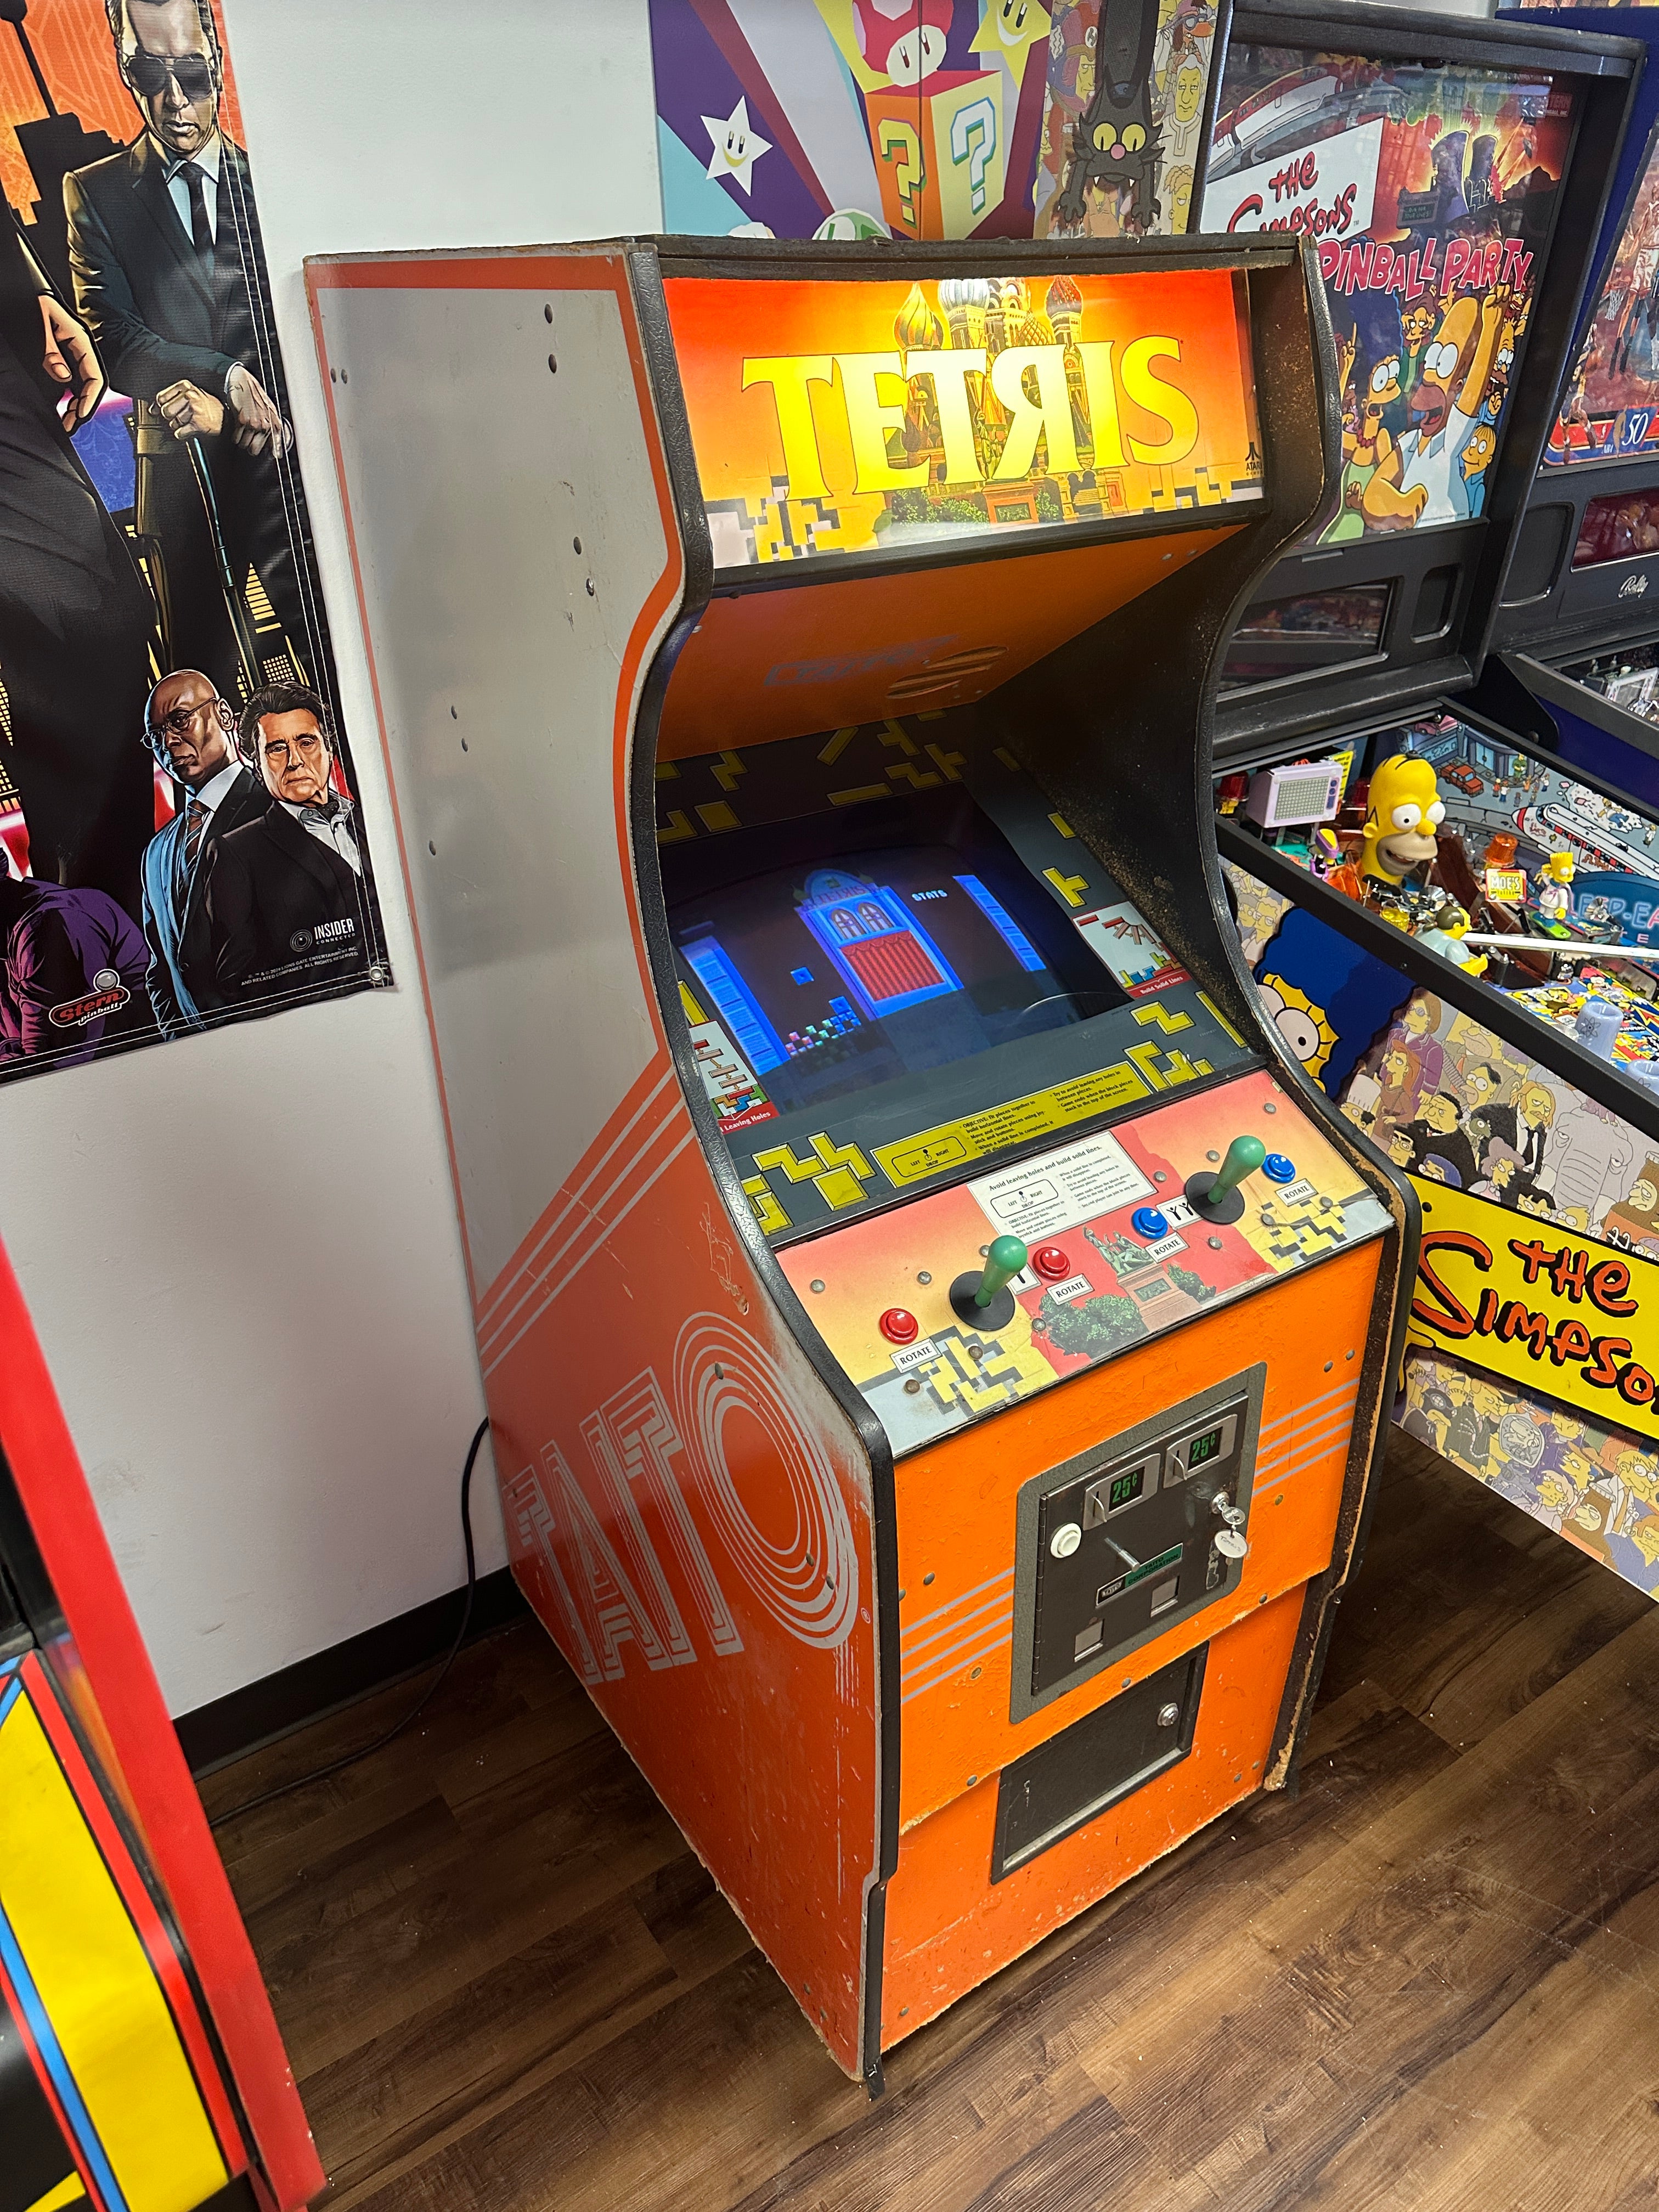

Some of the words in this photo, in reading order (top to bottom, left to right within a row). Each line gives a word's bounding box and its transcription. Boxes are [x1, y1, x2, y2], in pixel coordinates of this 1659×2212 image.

[1318, 238, 1437, 302] PINBALL
[1440, 238, 1534, 297] PARTY
[1622, 413, 1649, 446] 50
[1491, 876, 1521, 890] MOE'S
[911, 889, 948, 901] STATS
[314, 918, 354, 940] INSIDER
[316, 933, 356, 945] CONNECTED
[252, 974, 276, 983] RELATED
[1154, 980, 1169, 989] Solid
[59, 993, 119, 1020] Stern
[81, 1002, 119, 1022] pinball
[1079, 1079, 1096, 1088] leaving
[1119, 1079, 1133, 1088] pieces
[1056, 1092, 1076, 1102] between
[1076, 1087, 1093, 1096] pieces.
[996, 1109, 1011, 1118] pieces
[1011, 1102, 1030, 1111] together
[724, 1119, 752, 1131] Leaving
[750, 1111, 771, 1122] Holes
[966, 1126, 979, 1134] build
[979, 1118, 1003, 1130] horizontal
[1008, 1118, 1024, 1127] pieces
[995, 1128, 1015, 1137] buttons.
[935, 1148, 949, 1157] RIGHT
[989, 1182, 1006, 1192] Avoid
[1006, 1173, 1028, 1184] leaving
[1027, 1167, 1044, 1177] holes
[1045, 1161, 1056, 1170] and
[1057, 1156, 1071, 1166] build
[1072, 1150, 1086, 1160] solid
[1087, 1145, 1102, 1154] lines.
[1030, 1190, 1043, 1198] RIGHT
[1284, 1185, 1310, 1199] ROTATE
[1021, 1200, 1034, 1209] DROP
[1045, 1201, 1060, 1211] together
[1154, 1239, 1181, 1256] ROTATE
[1056, 1281, 1086, 1297] ROTATE
[1412, 1230, 1659, 1415] SIMPSO
[899, 1346, 932, 1364] ROTATE
[501, 1311, 859, 1686] TAITO
[1128, 1554, 1178, 1584] CORPORATION
[1144, 1556, 1164, 1570] TAITO
